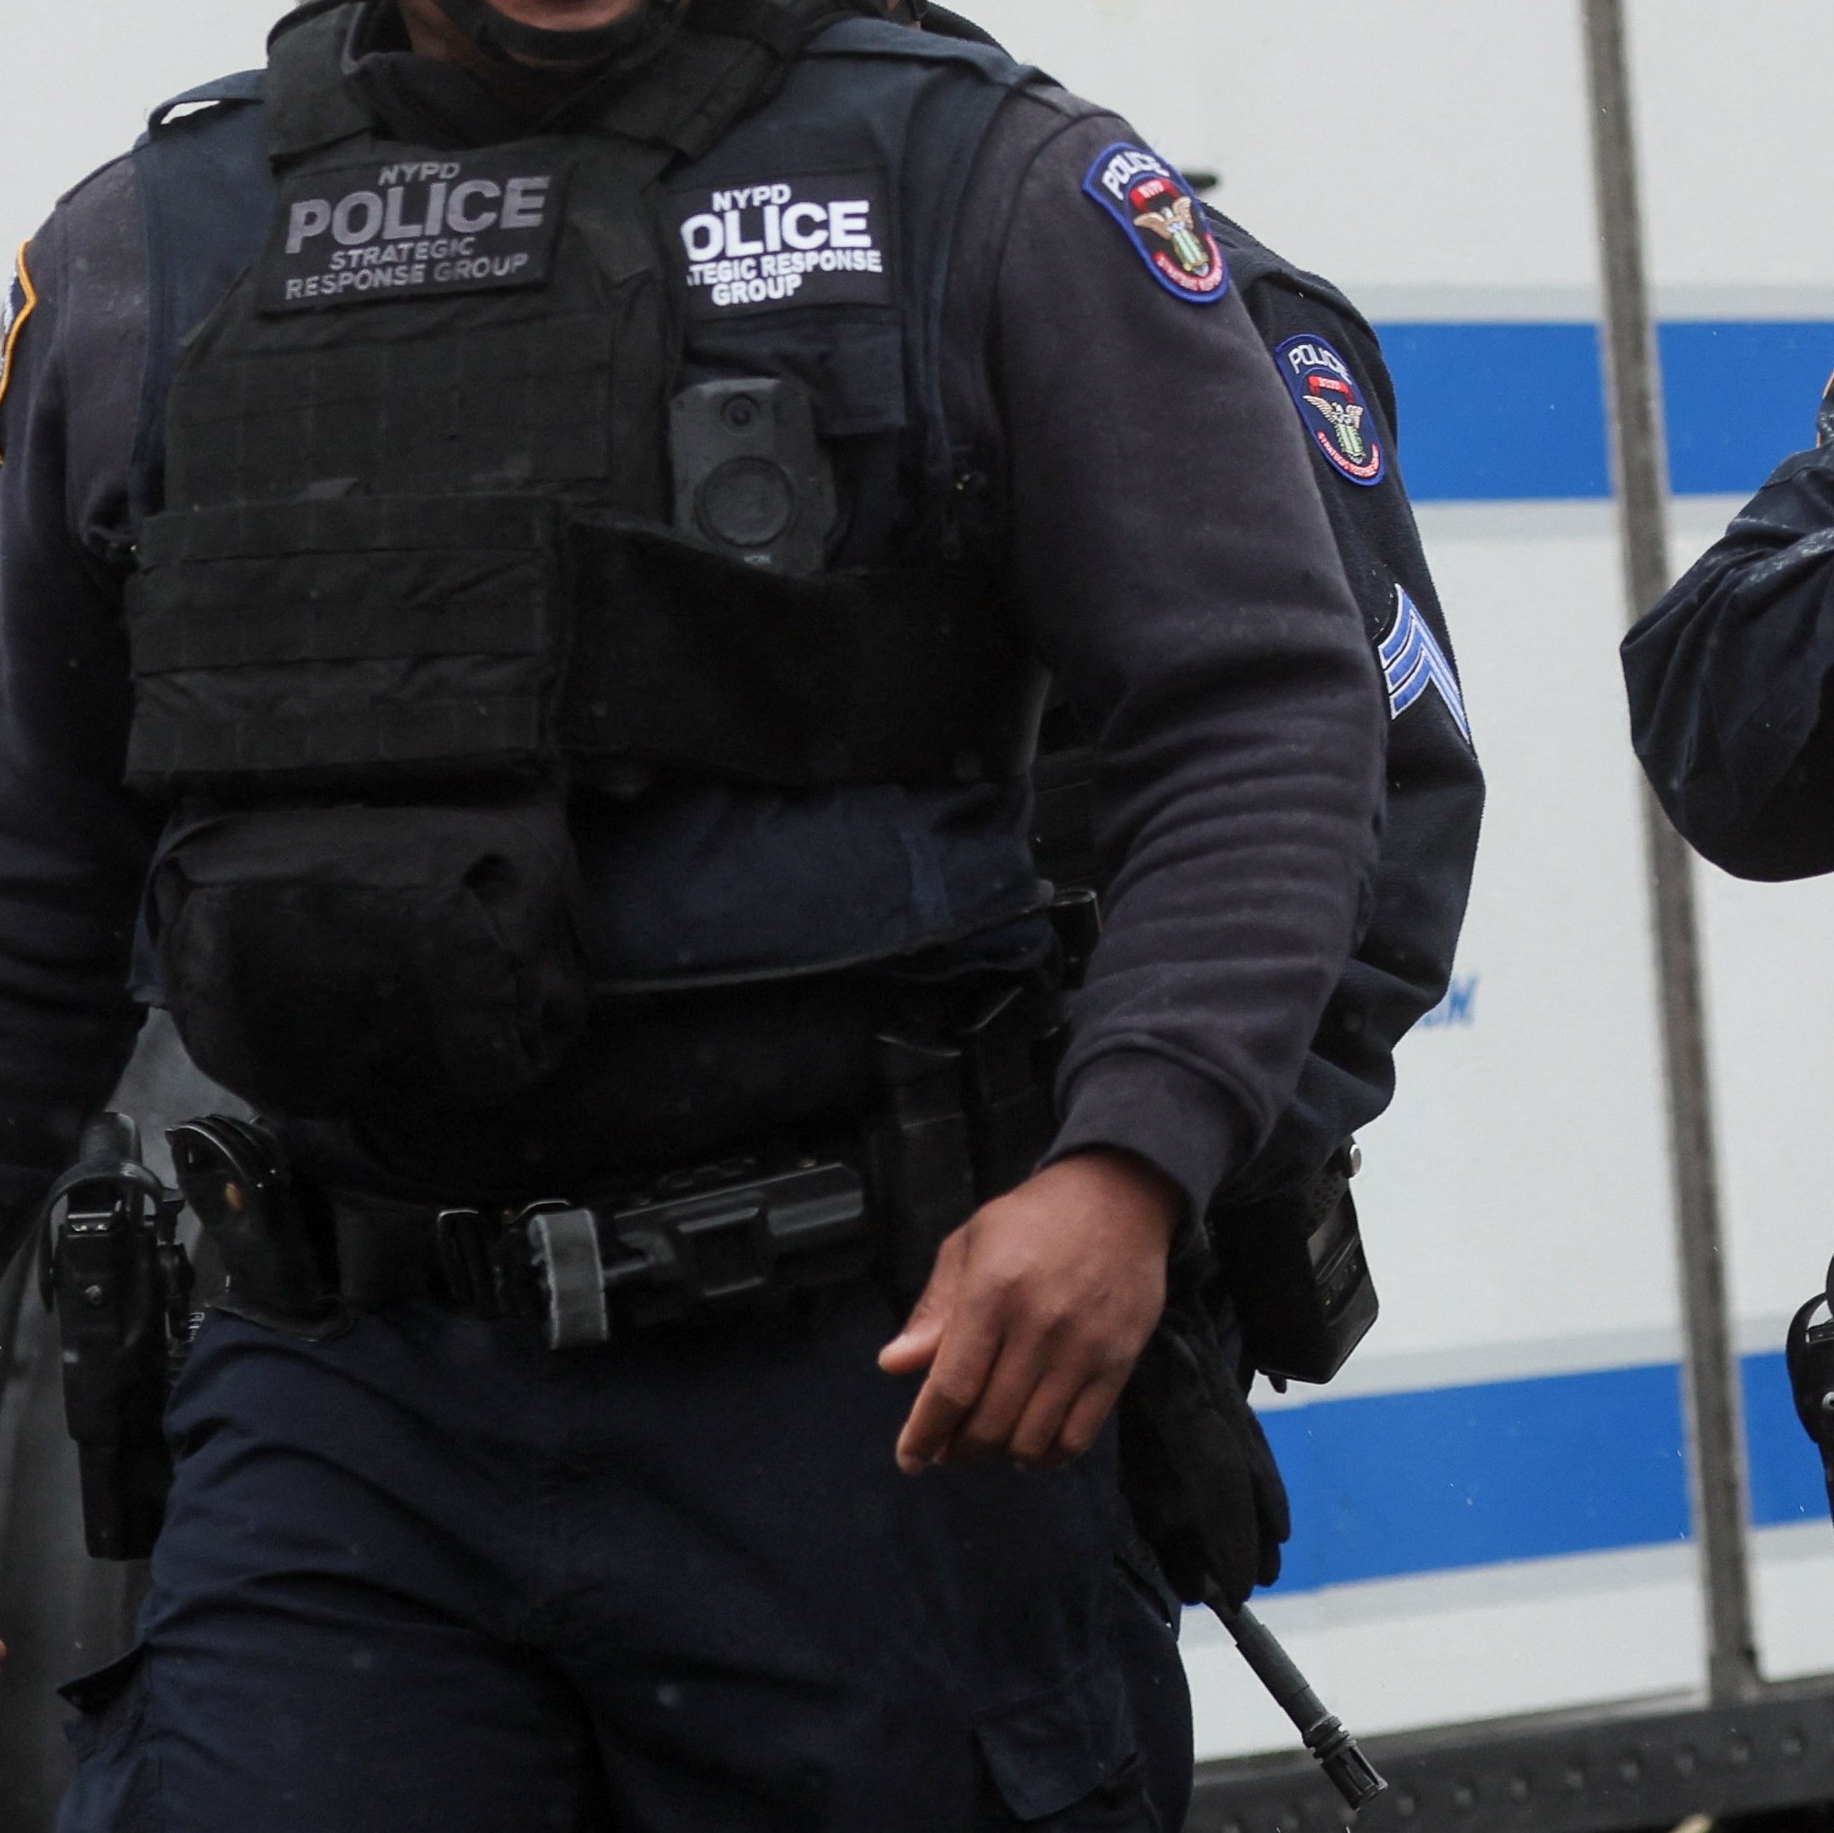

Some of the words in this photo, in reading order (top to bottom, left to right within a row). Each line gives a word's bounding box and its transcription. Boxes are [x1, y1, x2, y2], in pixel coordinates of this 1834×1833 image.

[378, 162, 460, 186] NYPD
[1102, 151, 1171, 200] POLICE
[285, 175, 551, 254] POLICE
[712, 183, 792, 212] NYPD
[680, 200, 872, 262] OLICE
[329, 236, 476, 270] STRATEGIC
[687, 257, 757, 286] TEGIC
[759, 249, 883, 278] RESPONSE
[285, 264, 426, 300] RESPONSE
[433, 253, 529, 282] GROUP
[711, 273, 802, 306] GROUP
[1288, 344, 1353, 385] POLICE
